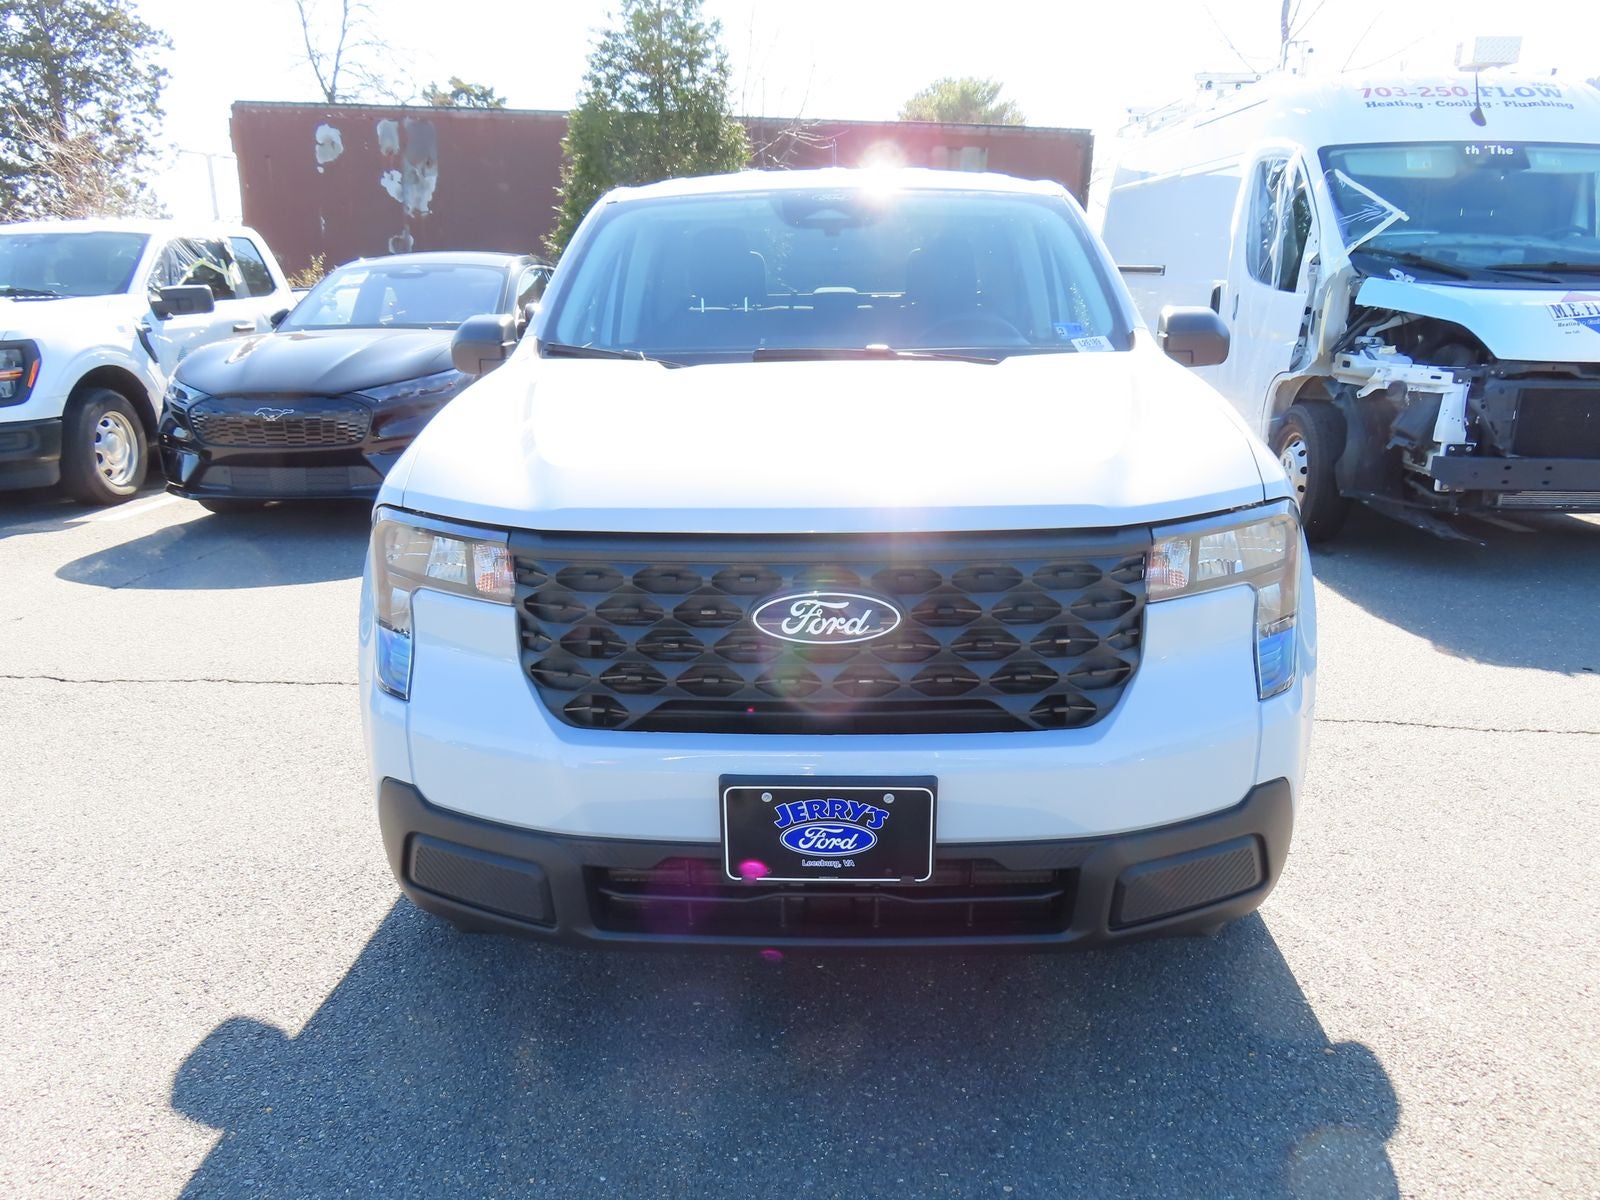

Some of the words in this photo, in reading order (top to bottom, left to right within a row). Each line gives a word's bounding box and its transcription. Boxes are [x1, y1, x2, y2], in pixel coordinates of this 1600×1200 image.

[1361, 86, 1562, 99] 703-250-FLOW
[1364, 99, 1424, 109] Heating
[1435, 99, 1492, 109] Cooling
[1504, 100, 1575, 110] Plumbing
[781, 599, 873, 635] Ford
[774, 798, 890, 830] JERRY'S
[798, 826, 859, 850] Ford
[842, 858, 856, 868] VA
